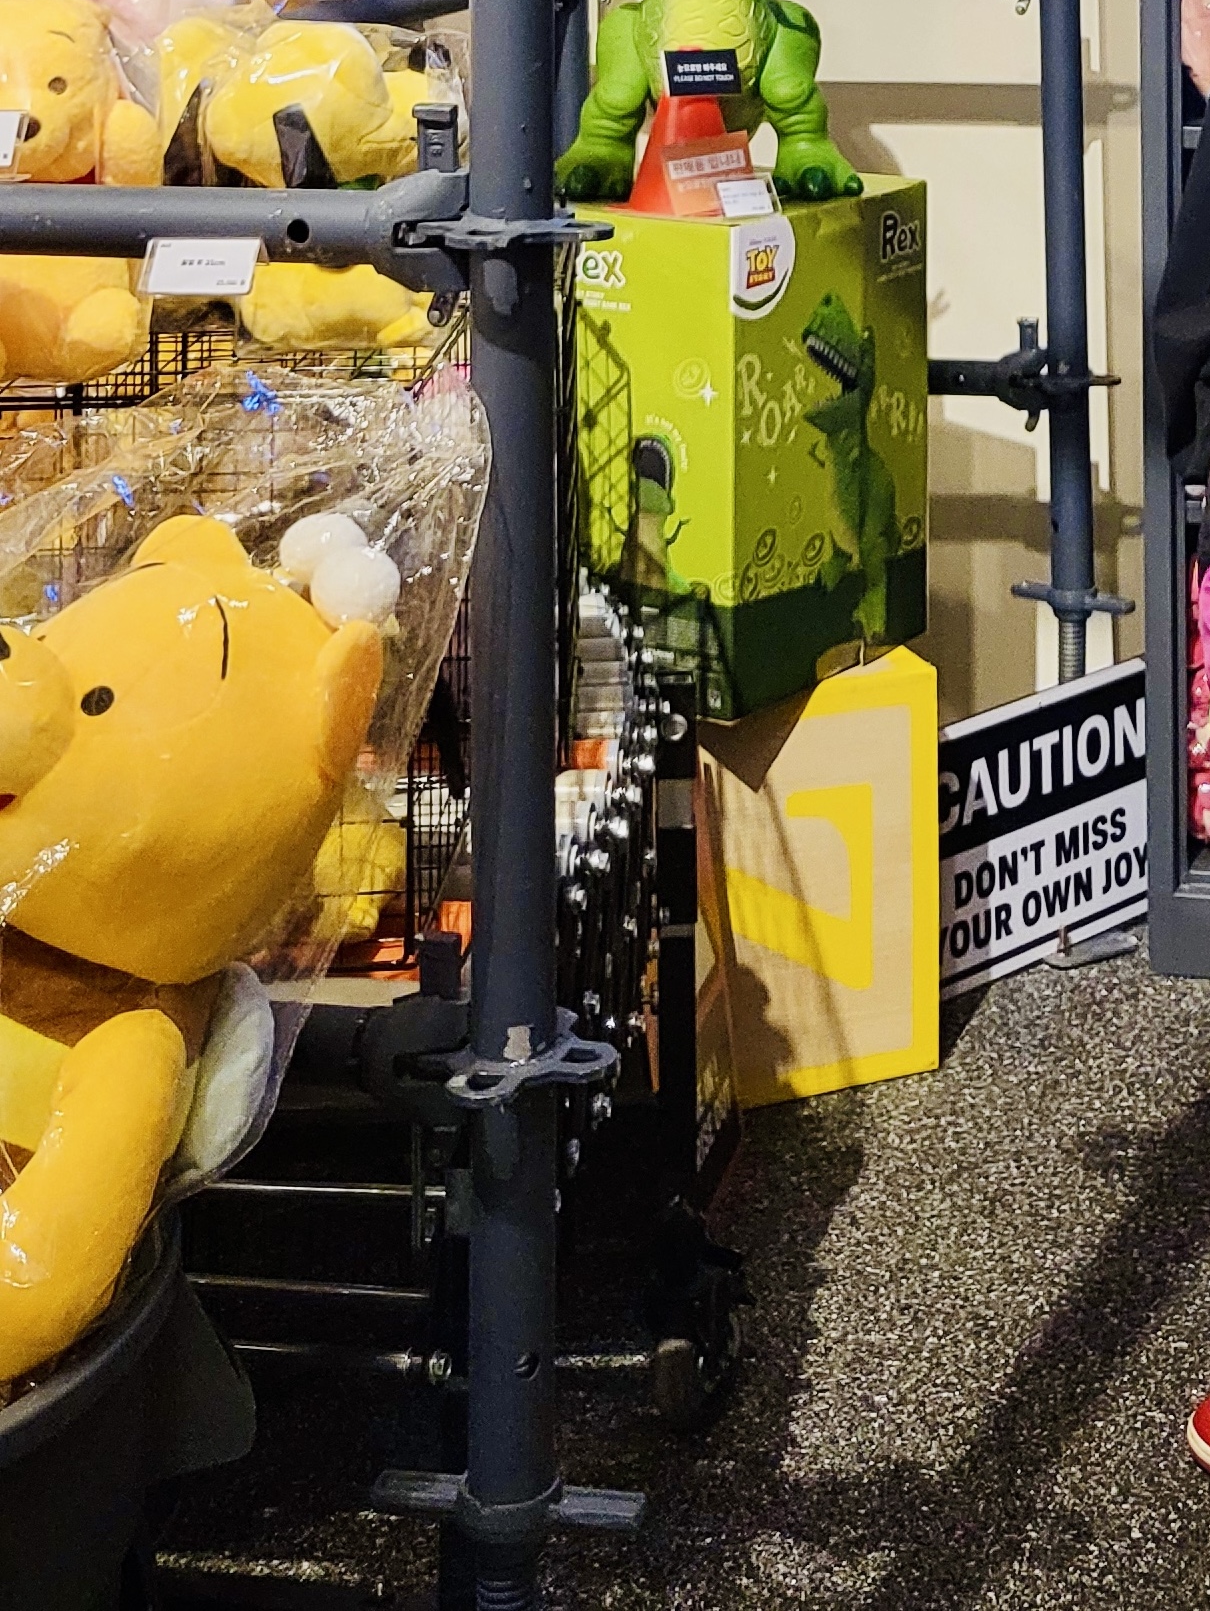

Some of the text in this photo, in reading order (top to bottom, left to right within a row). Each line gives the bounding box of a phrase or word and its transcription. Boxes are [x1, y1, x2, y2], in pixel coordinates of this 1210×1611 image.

[673, 75, 693, 83] PLEASE
[716, 74, 734, 82] TOUCH
[745, 245, 780, 272] TOY
[881, 213, 919, 261] Rex
[939, 697, 1146, 836] CAUTION
[955, 807, 1127, 910] DON'T MISS
[1022, 865, 1093, 929] OWN
[1103, 842, 1148, 896] JOY
